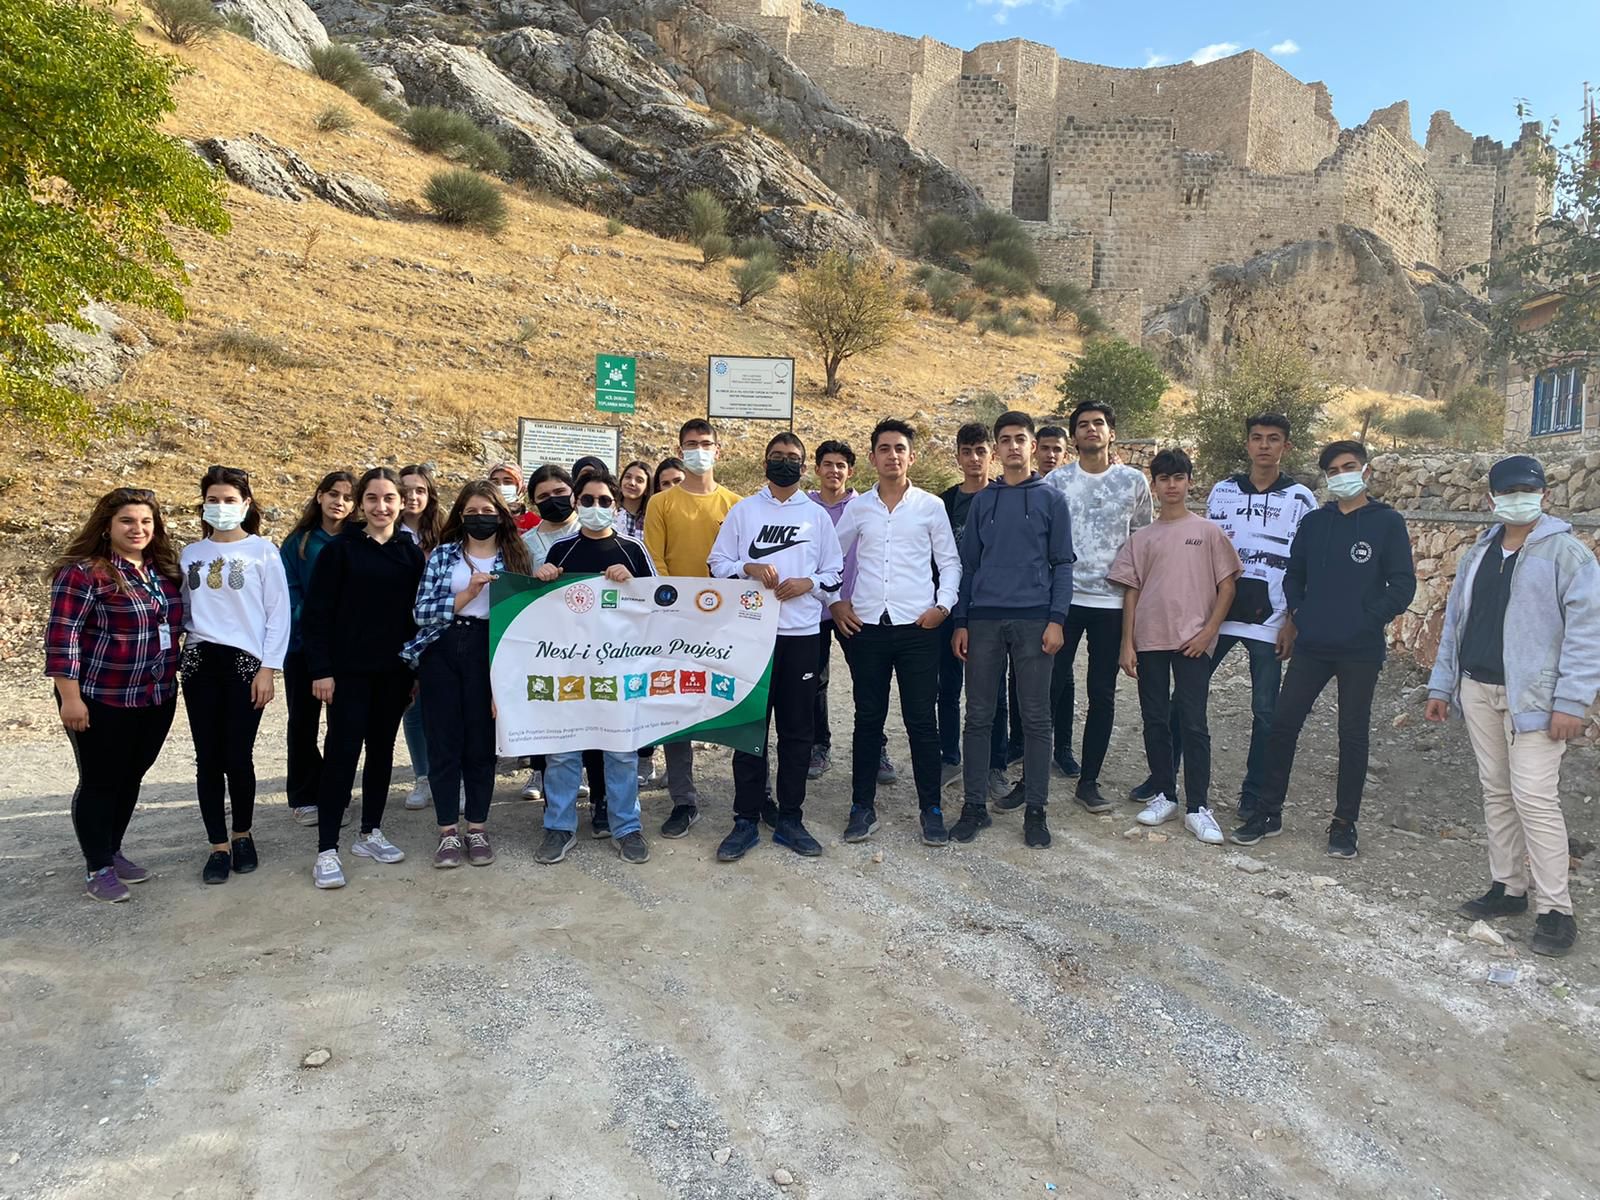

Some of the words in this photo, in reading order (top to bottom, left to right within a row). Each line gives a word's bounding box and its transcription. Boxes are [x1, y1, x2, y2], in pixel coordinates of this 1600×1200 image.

[756, 525, 800, 543] NIKE
[535, 640, 591, 660] Nesl-i
[596, 641, 663, 665] Şahane
[669, 639, 733, 660] Projesi
